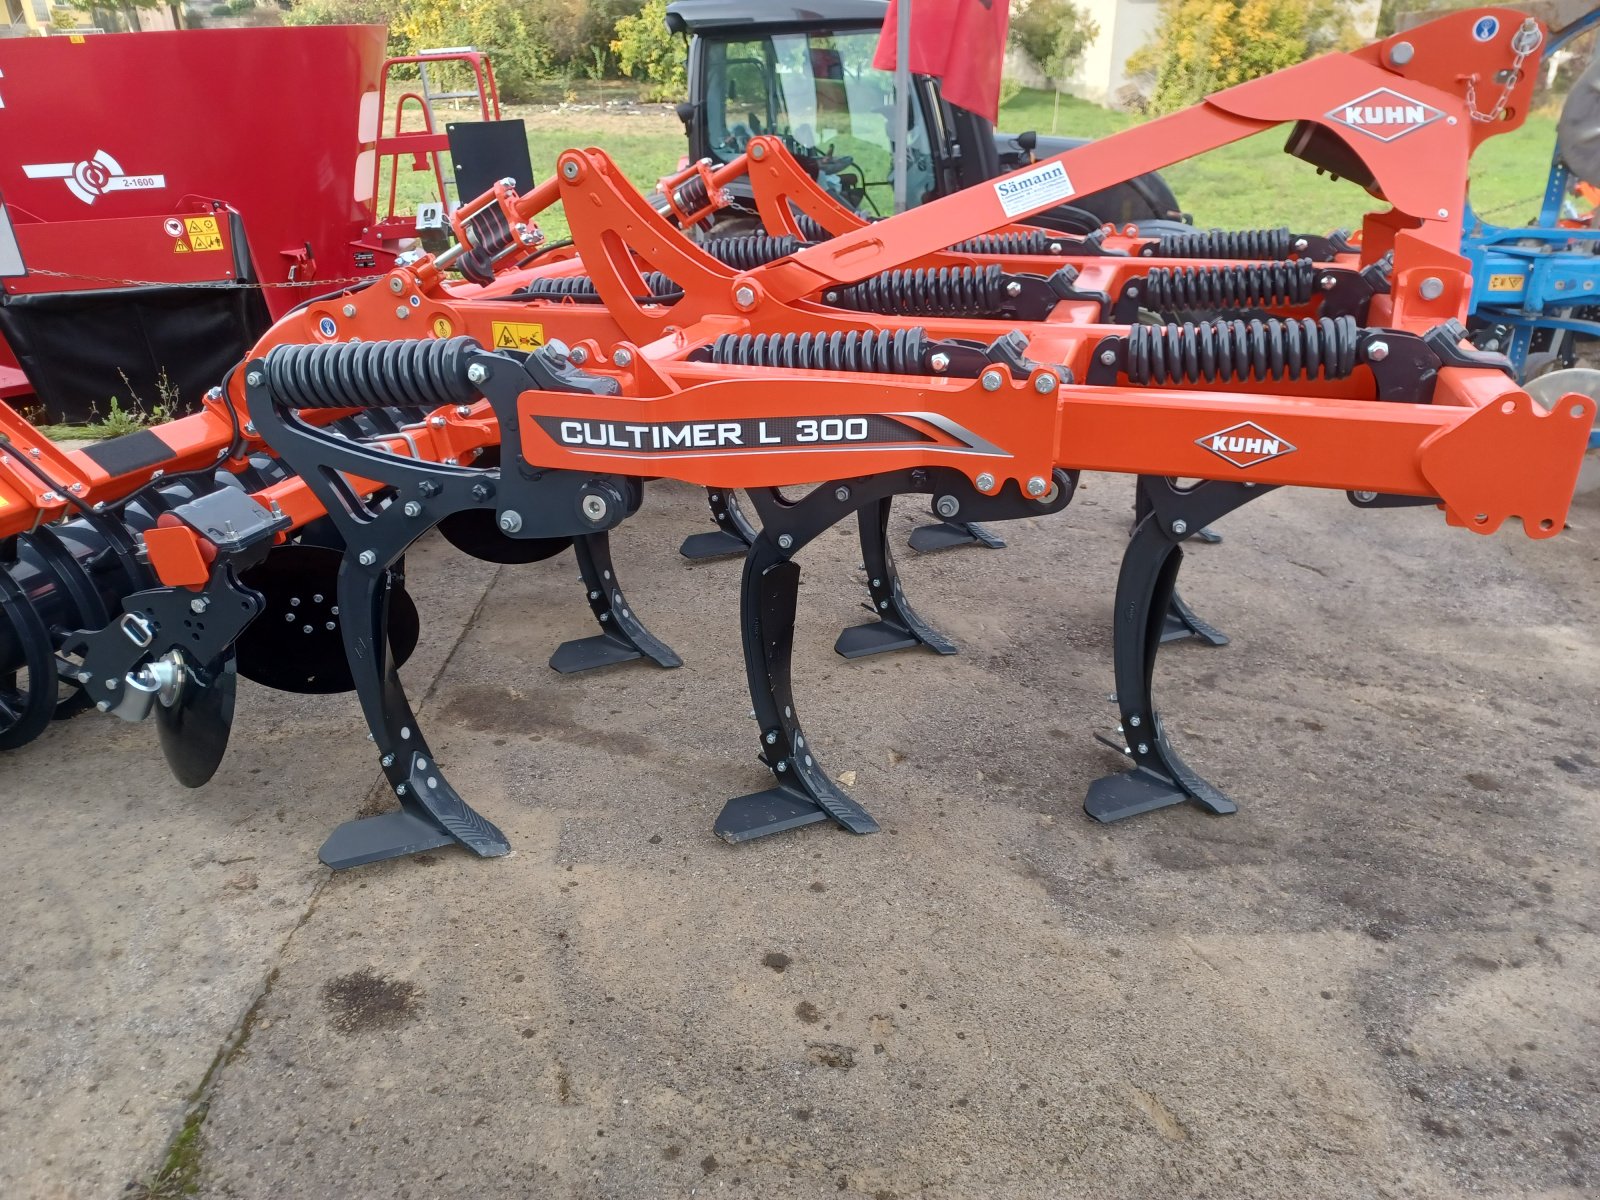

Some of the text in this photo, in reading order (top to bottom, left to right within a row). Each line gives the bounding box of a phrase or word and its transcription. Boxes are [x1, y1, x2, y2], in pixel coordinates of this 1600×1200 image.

[1345, 106, 1425, 124] KUHN
[122, 178, 155, 187] 2-1600
[998, 167, 1063, 197] Sämann
[560, 418, 869, 448] CULTIMER L 300
[1212, 435, 1280, 455] KUHN
